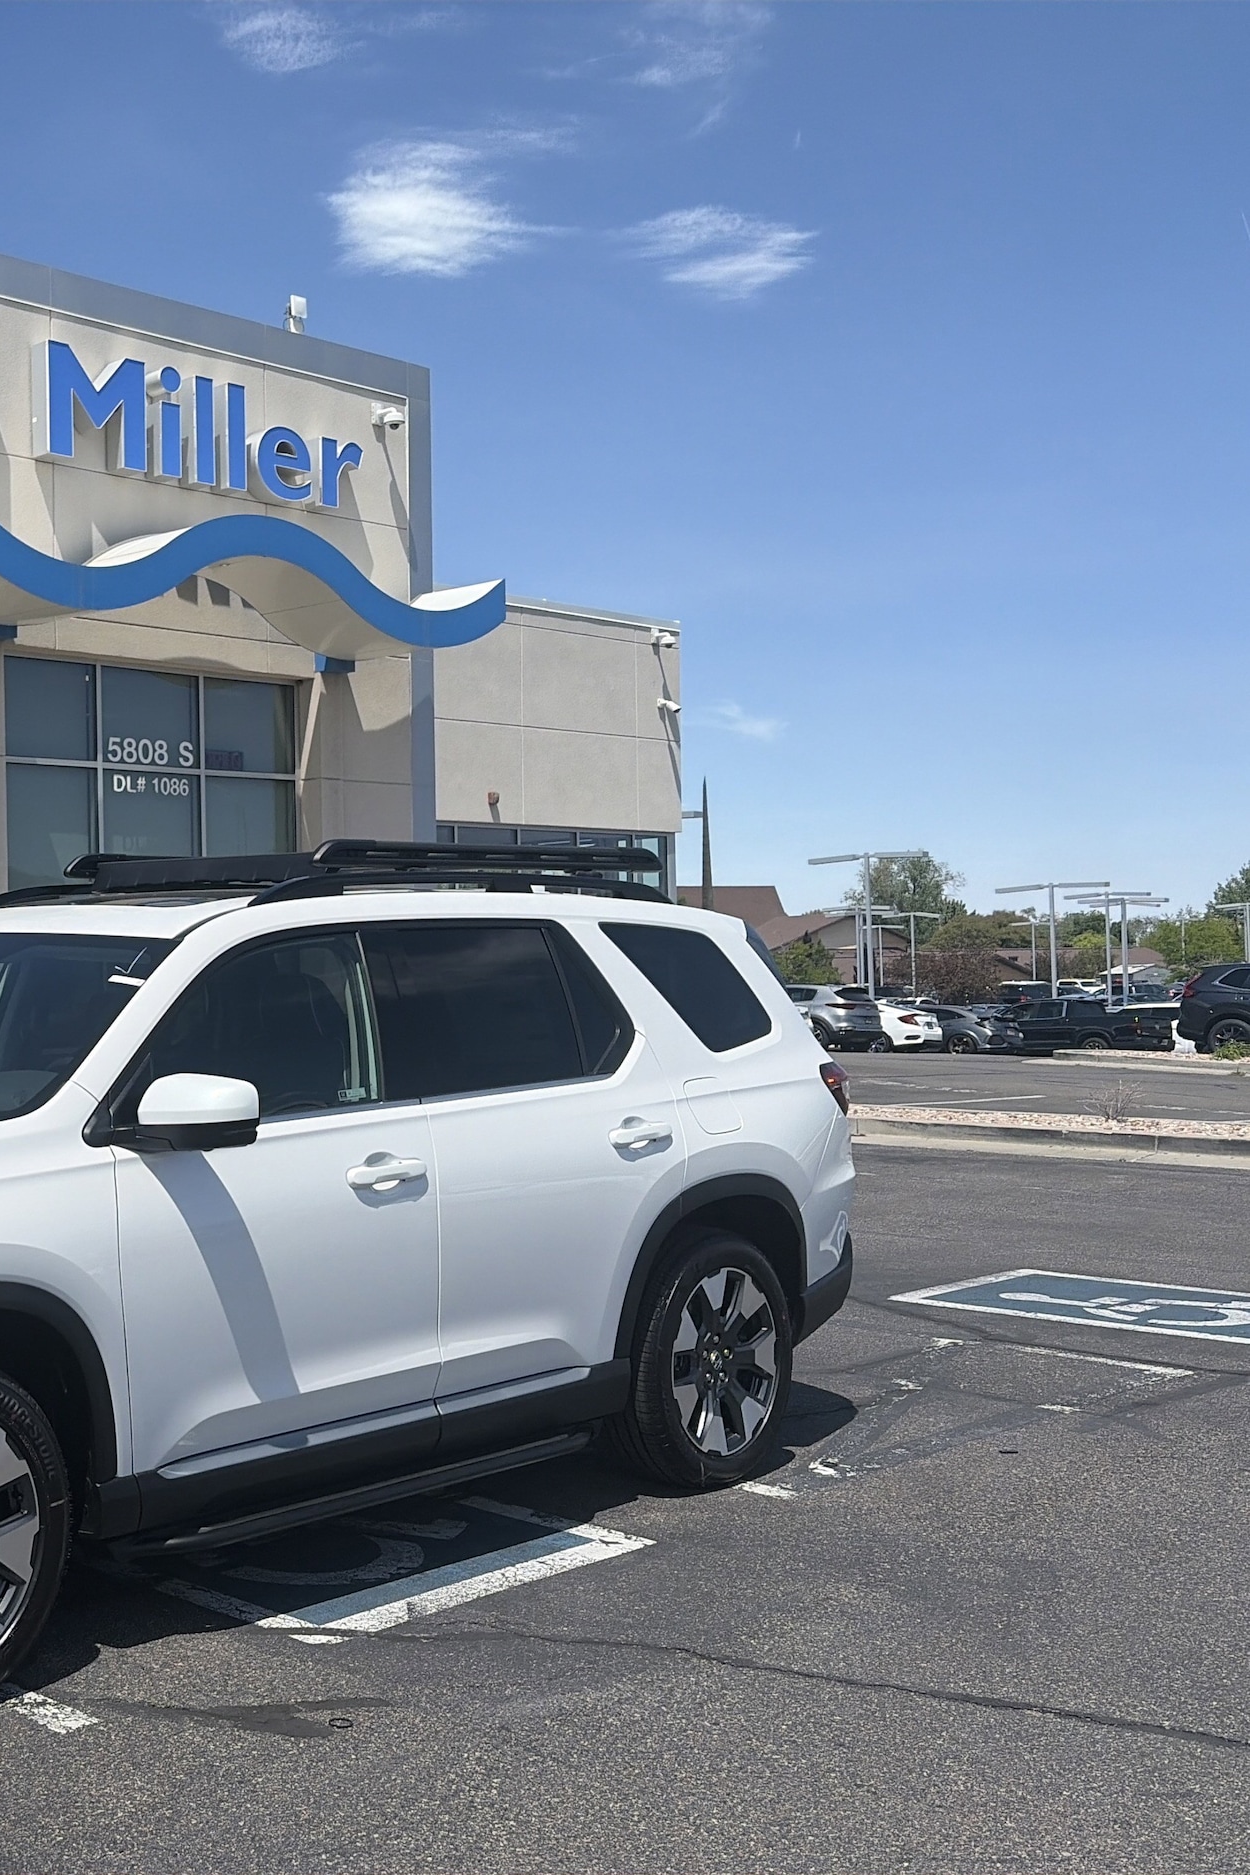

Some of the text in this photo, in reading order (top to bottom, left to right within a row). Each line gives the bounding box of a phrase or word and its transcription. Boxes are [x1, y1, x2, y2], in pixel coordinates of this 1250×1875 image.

[48, 339, 364, 509] Miller
[107, 736, 194, 767] 5808 S
[113, 774, 189, 796] DL# 1086
